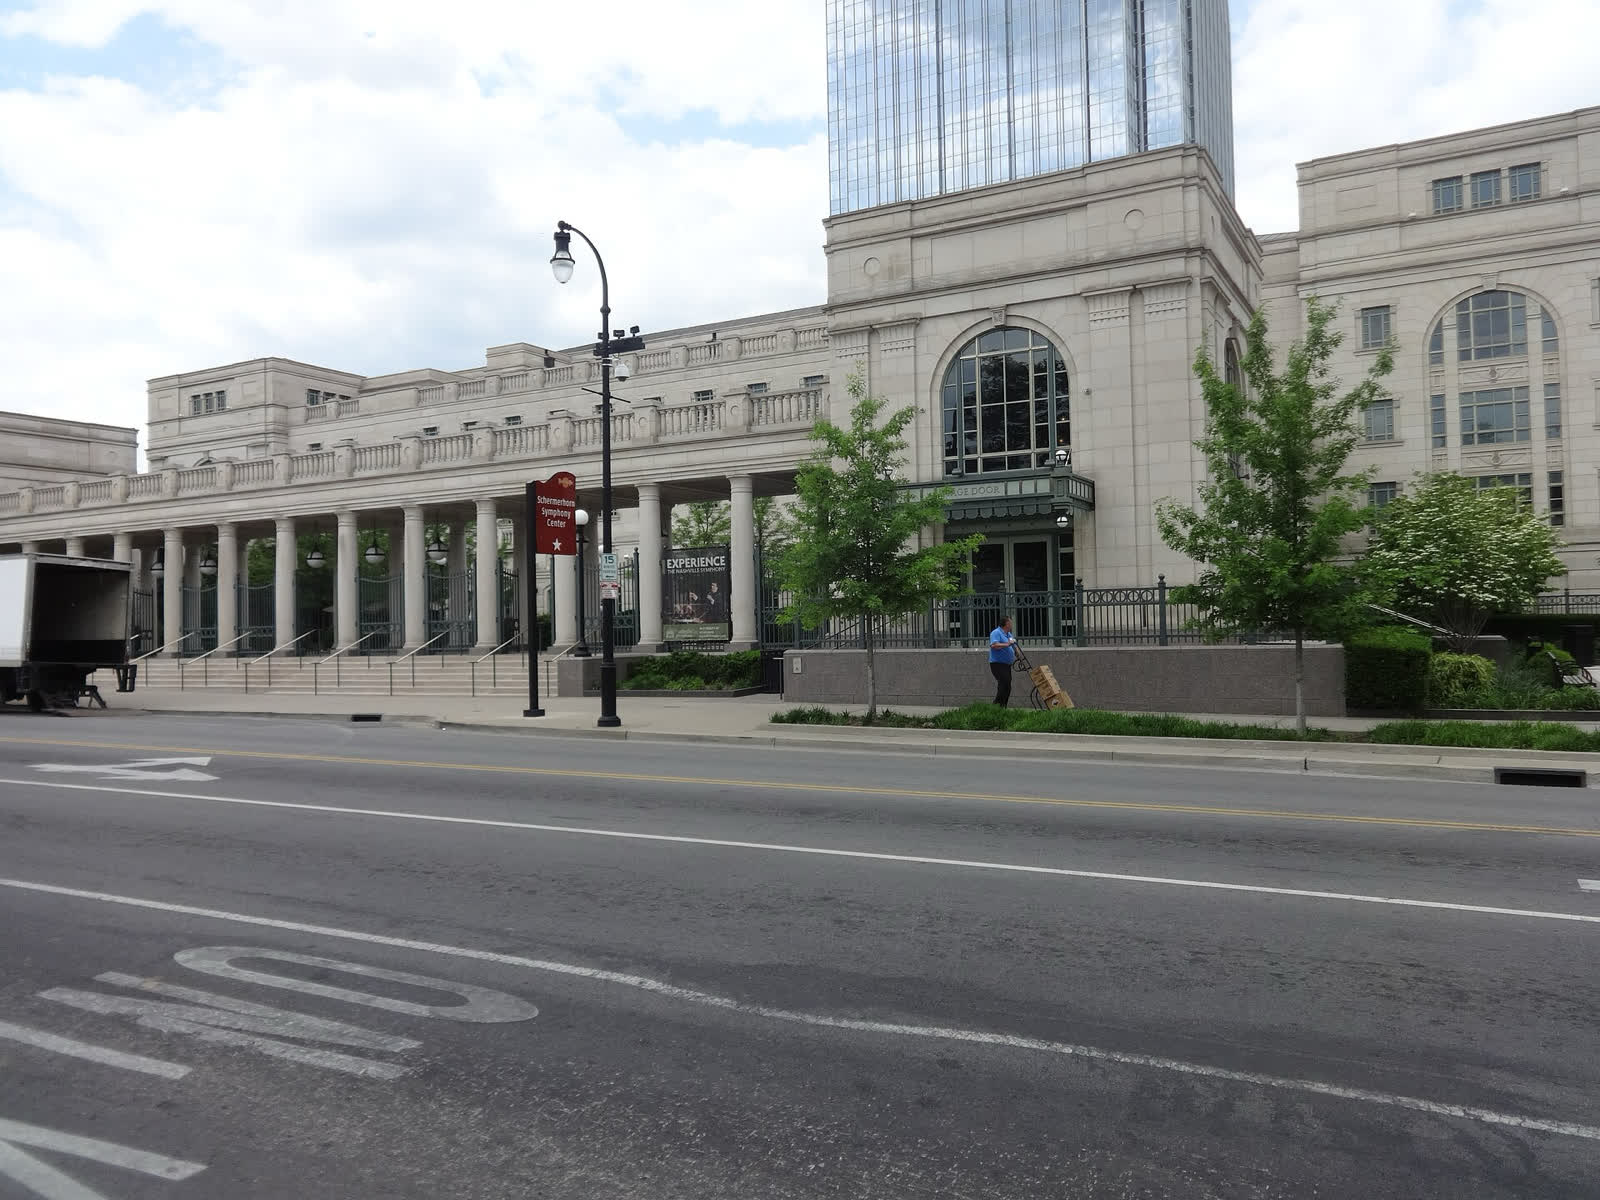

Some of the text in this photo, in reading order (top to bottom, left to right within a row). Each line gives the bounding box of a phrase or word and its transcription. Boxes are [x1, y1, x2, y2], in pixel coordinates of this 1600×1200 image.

[971, 486, 1000, 496] DOOR
[537, 496, 575, 507] Schermerhorn
[541, 507, 571, 519] Symphony
[547, 519, 566, 528] Center
[604, 555, 614, 564] 15
[666, 556, 726, 569] EXPERIENCE
